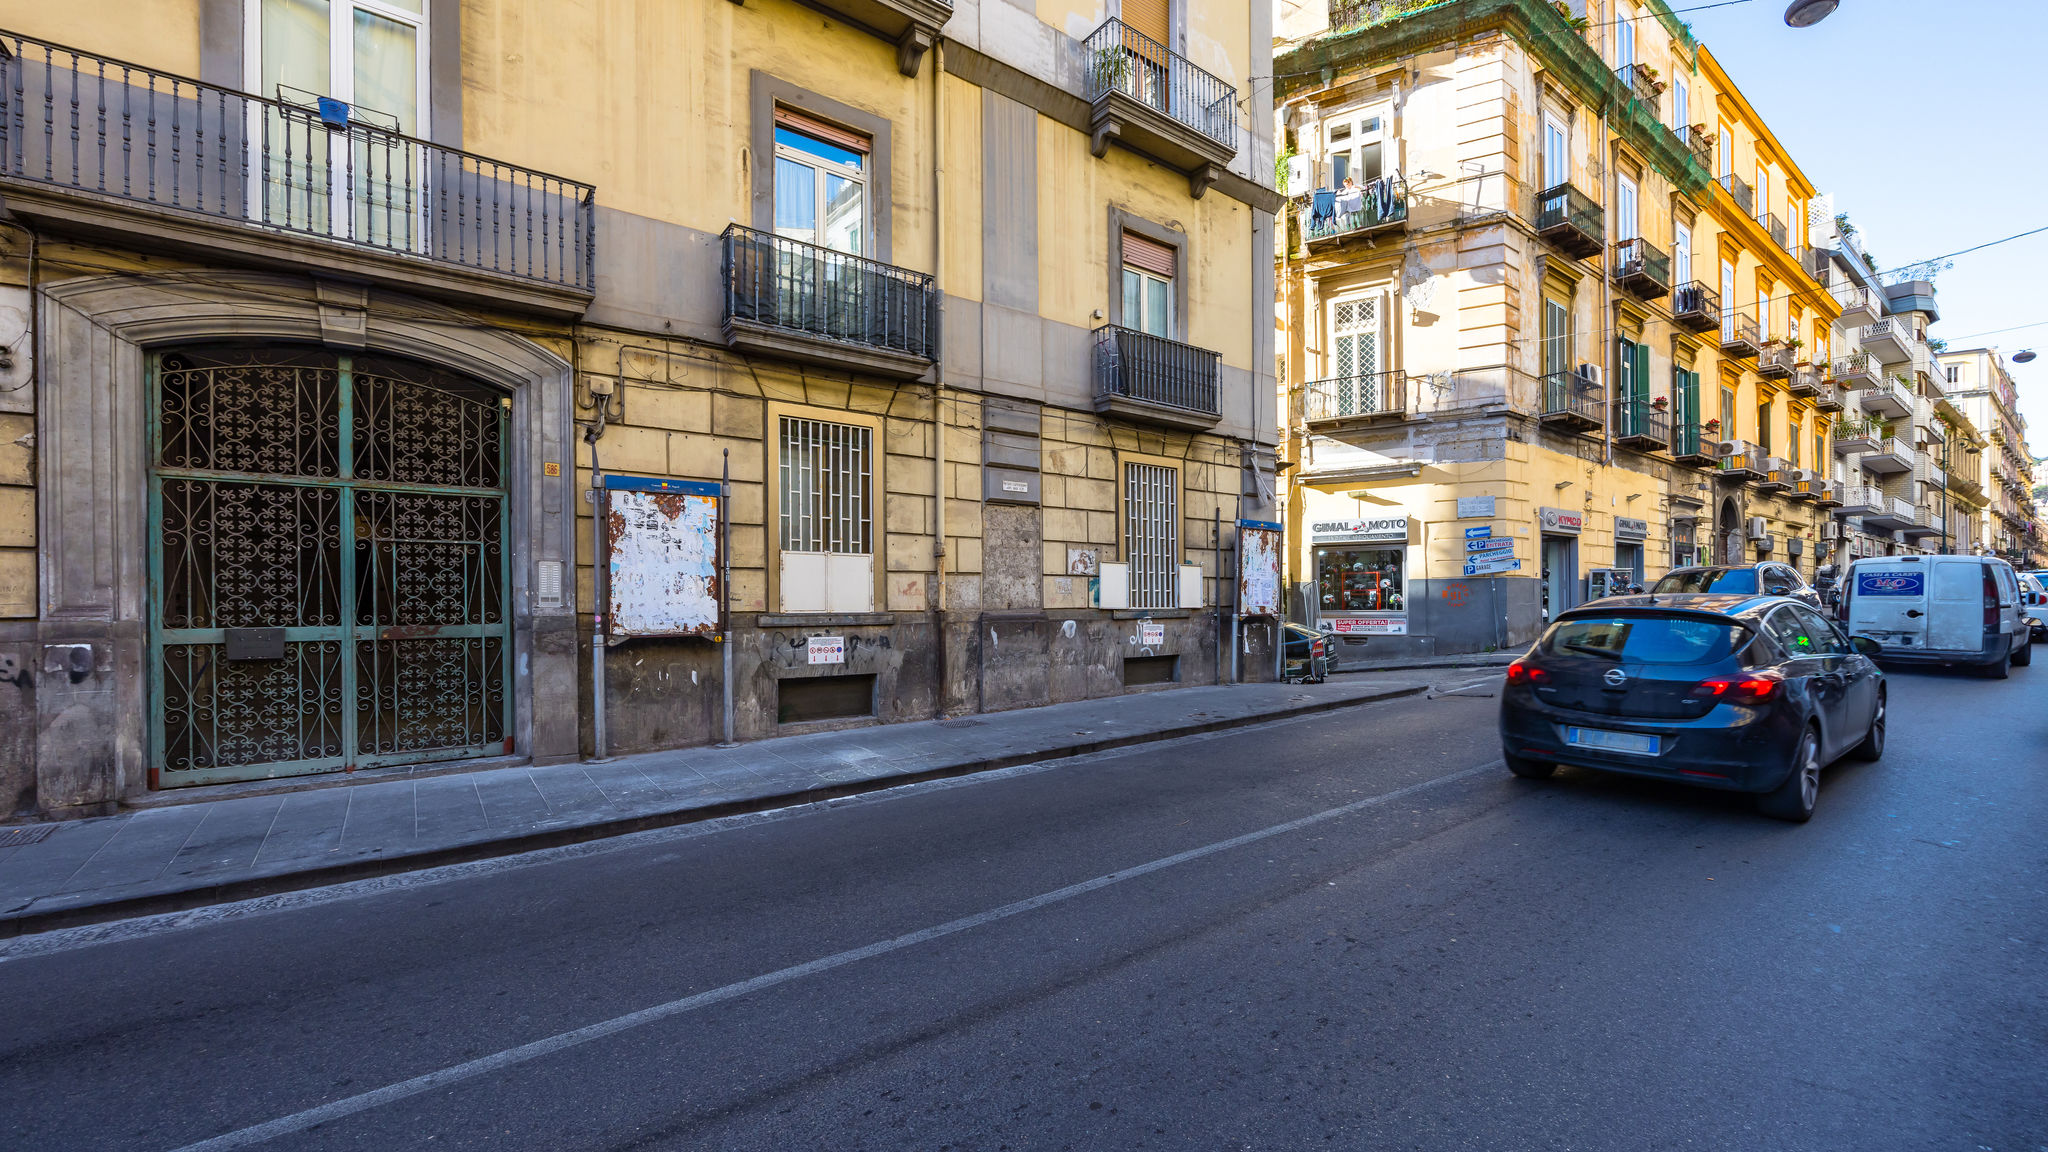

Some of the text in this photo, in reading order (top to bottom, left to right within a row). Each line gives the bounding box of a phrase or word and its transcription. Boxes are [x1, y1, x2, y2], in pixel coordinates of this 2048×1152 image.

[1312, 519, 1406, 533] GIMAL MOTO
[1558, 515, 1582, 526] KYMCO
[1479, 549, 1512, 559] PARCHEGGIO
